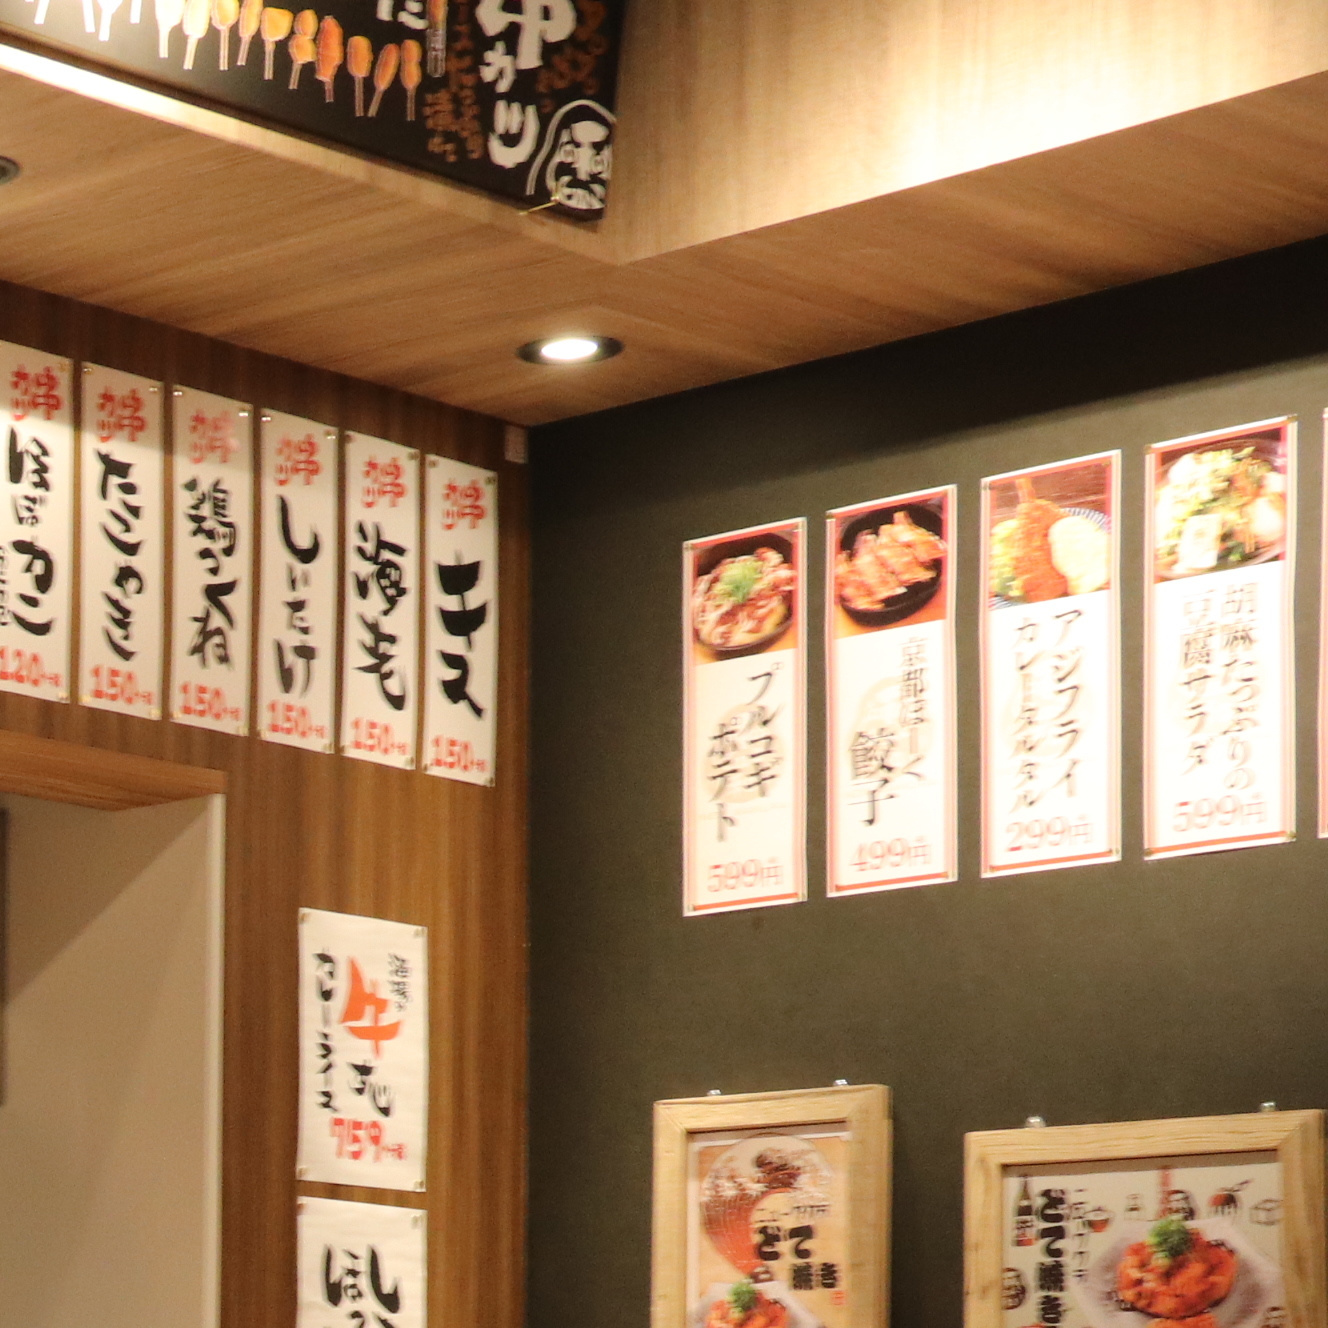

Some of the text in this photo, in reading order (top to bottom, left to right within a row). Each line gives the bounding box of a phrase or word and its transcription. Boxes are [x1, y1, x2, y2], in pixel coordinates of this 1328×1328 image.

[276, 495, 321, 694] しいたけ
[436, 560, 488, 719] キス
[745, 662, 784, 798] プルコギ
[1010, 616, 1039, 814] カレータルタル
[1050, 608, 1084, 800] アジフライ
[1178, 588, 1217, 776] 豆腐サラダ
[1220, 582, 1260, 792] 胡麻たっぷりの
[708, 715, 740, 842] ポテト
[848, 727, 897, 827] 餃子
[1004, 816, 1092, 852] 299円
[1172, 792, 1268, 834] 599円
[708, 857, 784, 894] 599円
[848, 838, 932, 873] 499円
